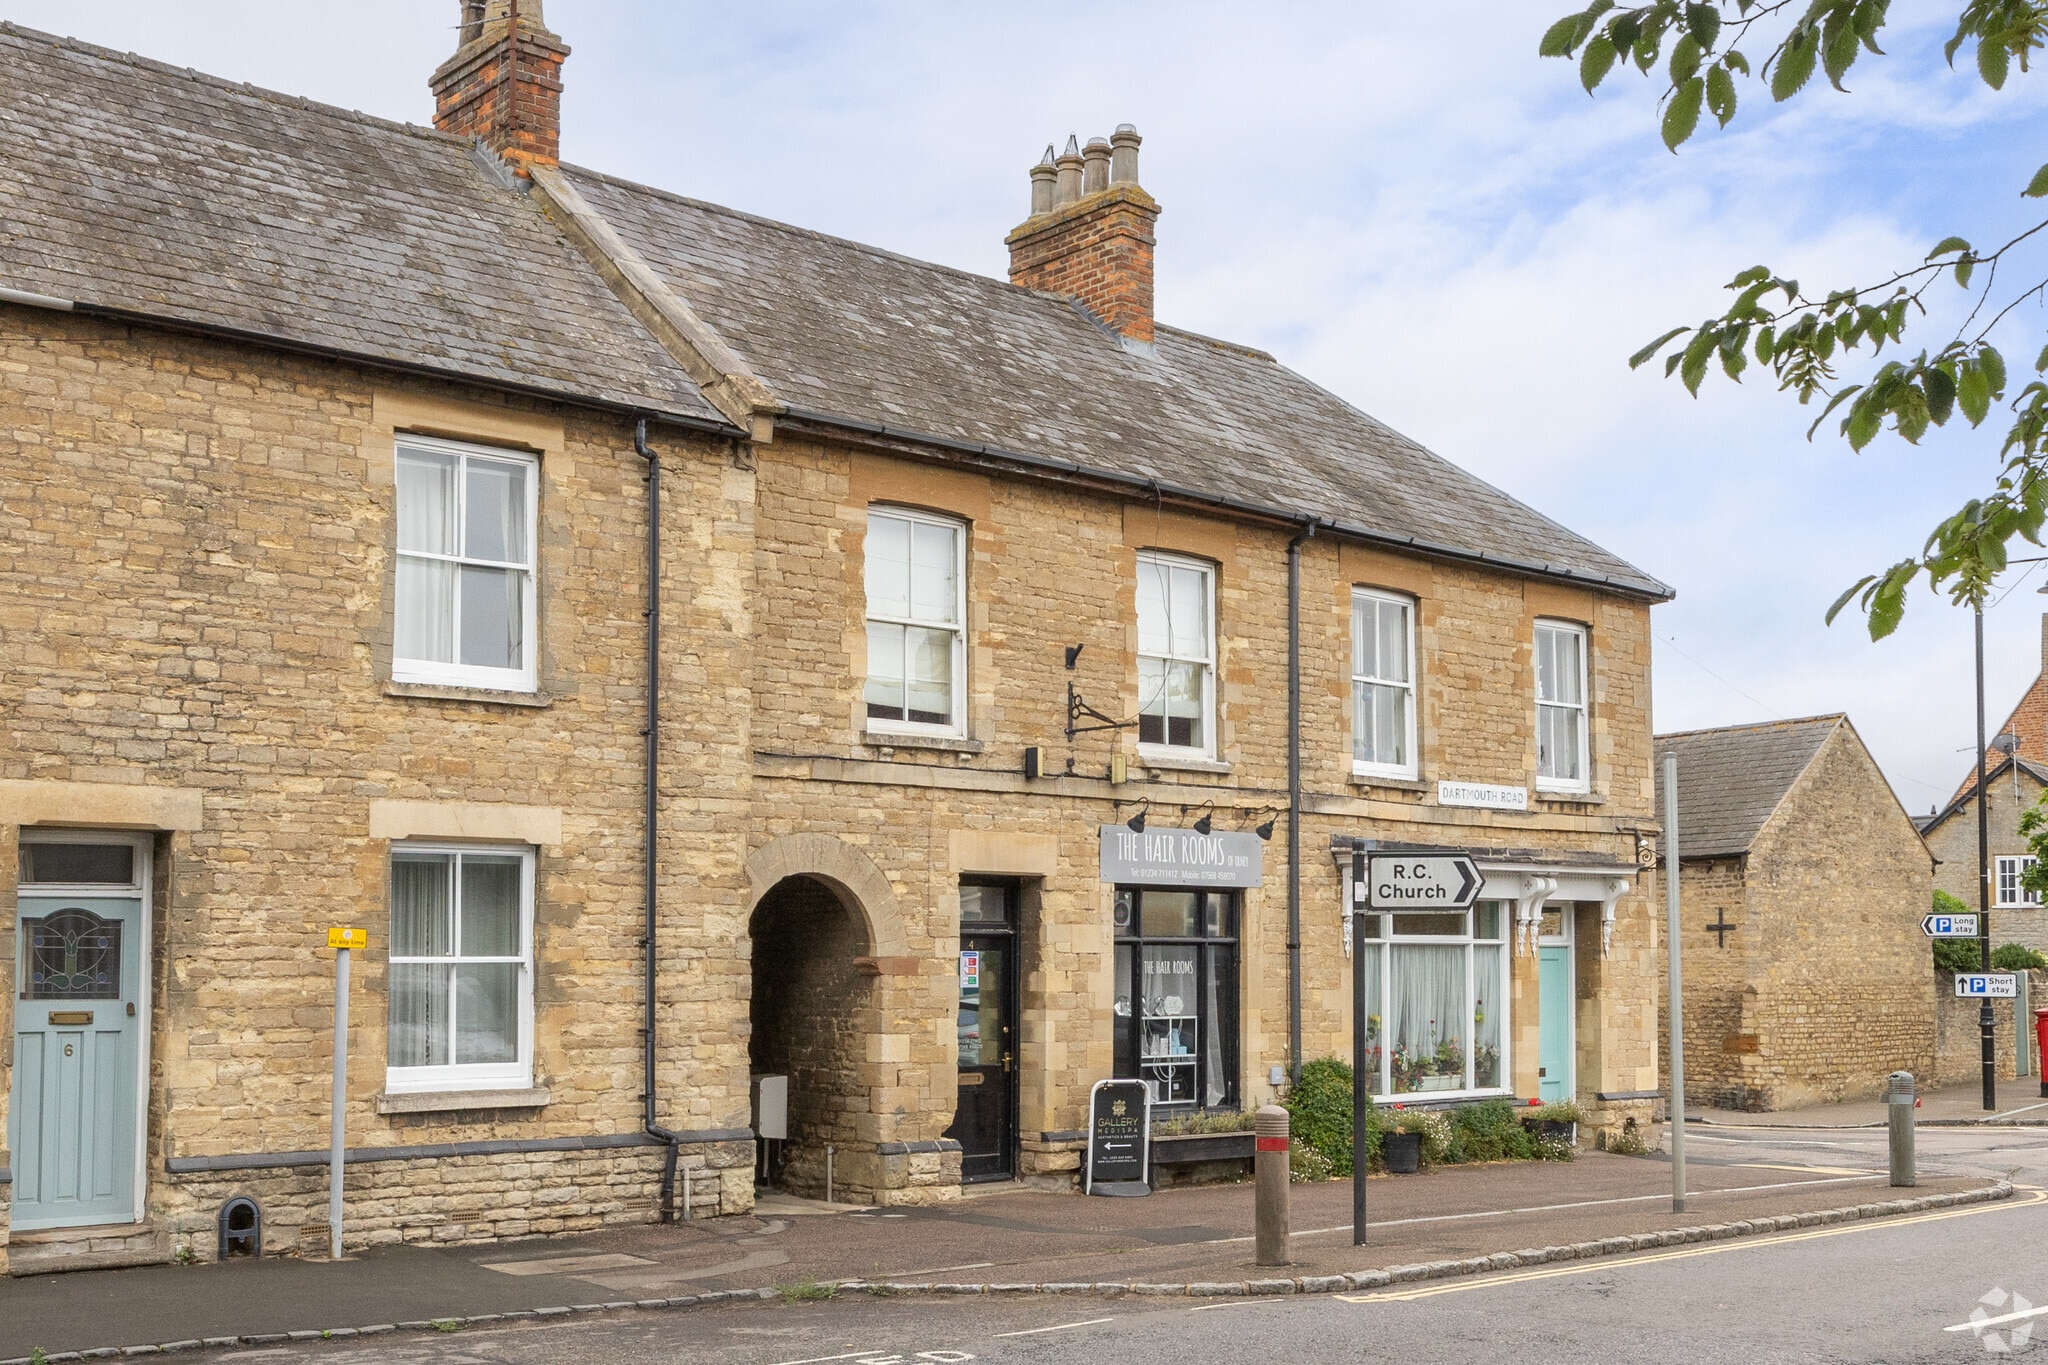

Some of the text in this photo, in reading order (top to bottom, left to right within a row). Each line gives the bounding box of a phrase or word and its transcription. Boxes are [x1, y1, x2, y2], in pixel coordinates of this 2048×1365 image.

[1442, 787, 1523, 804] DARTMOUTH ROAD
[1117, 833, 1138, 861] THE
[1145, 834, 1176, 863] HAIR
[1182, 835, 1224, 866] ROOMS
[1140, 868, 1157, 878] 01234
[1158, 869, 1178, 879] 711412
[1393, 864, 1432, 879] R.C.
[1378, 883, 1446, 899] Church
[1940, 917, 1974, 932] P Long
[968, 940, 974, 950] 4
[1144, 960, 1193, 974] THE HAIR ROOMS
[1974, 977, 2013, 992] P Short
[1991, 986, 2010, 994] stay
[64, 1044, 74, 1057] 6
[1097, 1117, 1139, 1127] GALLERY
